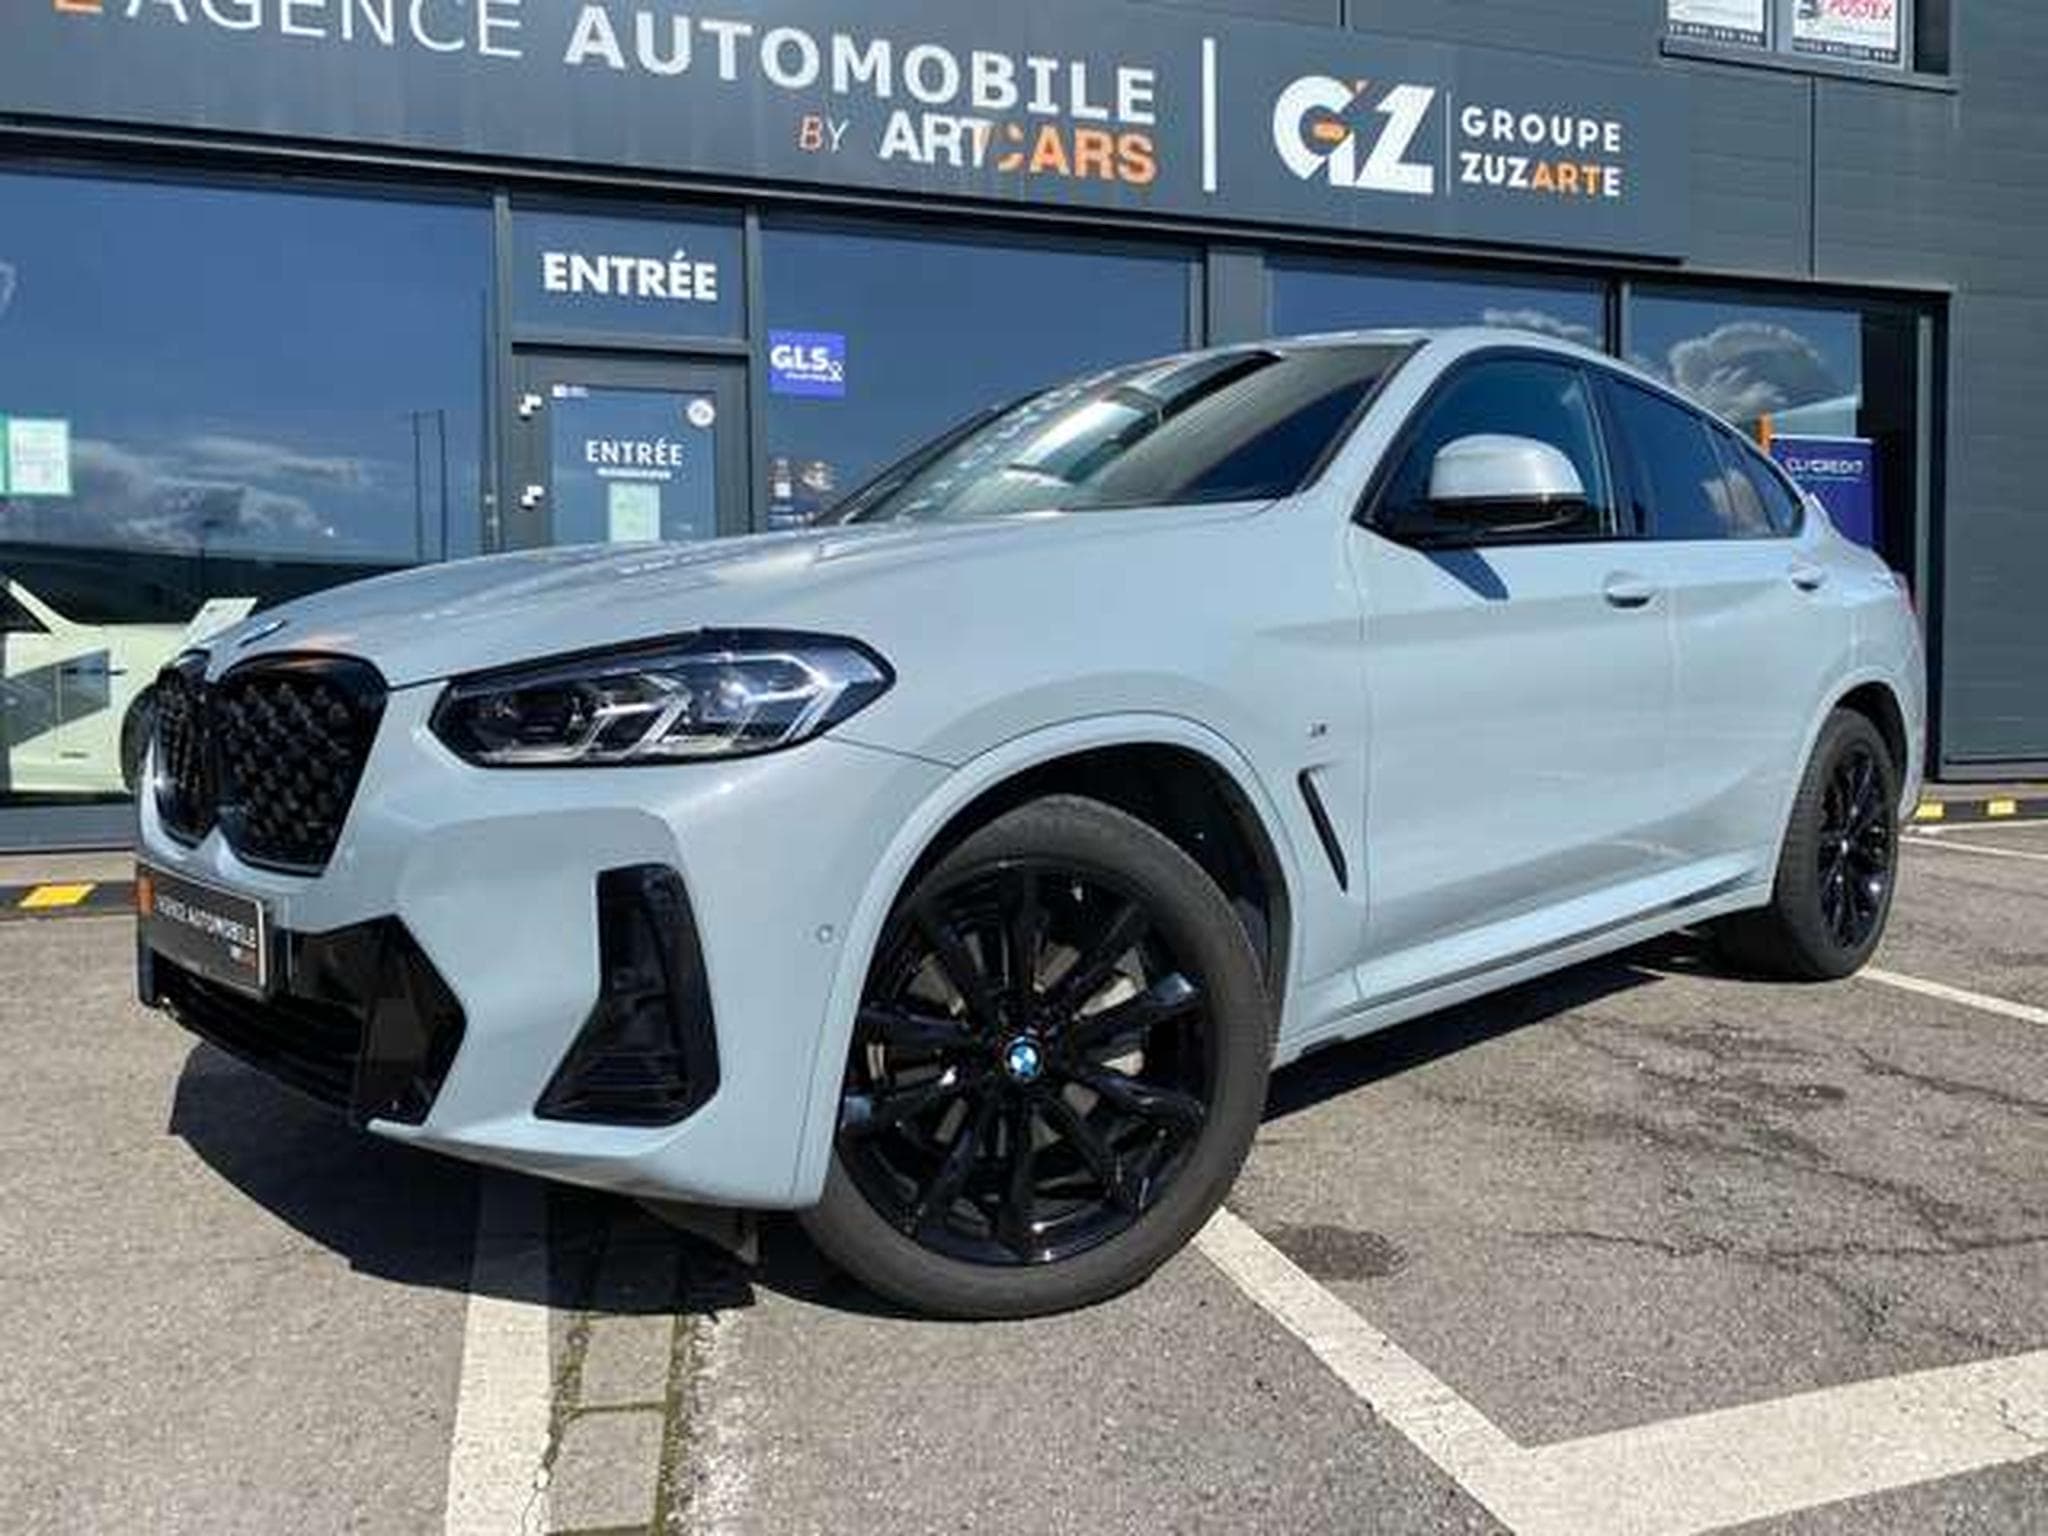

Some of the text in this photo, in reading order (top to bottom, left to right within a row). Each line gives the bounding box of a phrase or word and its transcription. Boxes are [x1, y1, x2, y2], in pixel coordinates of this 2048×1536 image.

[563, 4, 1156, 125] AUTOMOBILE
[799, 115, 849, 152] BY
[1460, 107, 1622, 152] GROUPE
[1459, 152, 1622, 197] ZUZARTE
[542, 250, 718, 300] ENTRÉE
[770, 344, 829, 370] GLS
[586, 438, 684, 466] ENTRÉE
